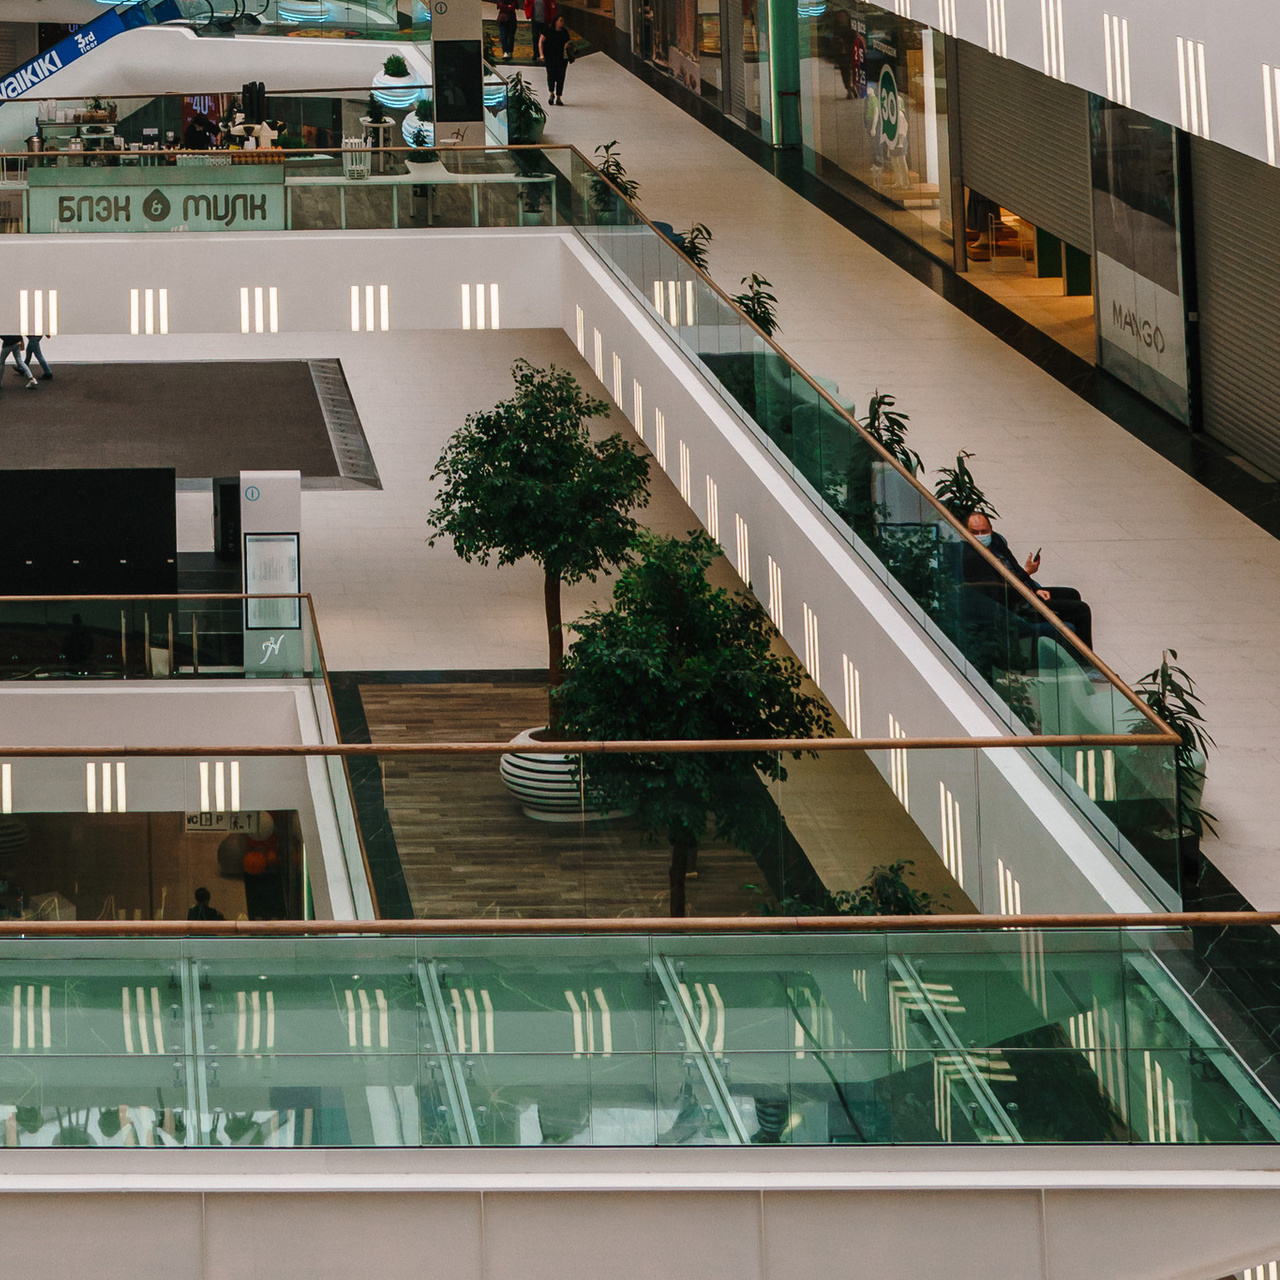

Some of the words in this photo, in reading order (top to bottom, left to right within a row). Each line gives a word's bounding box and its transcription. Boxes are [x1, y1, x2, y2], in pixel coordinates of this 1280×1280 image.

[74, 31, 96, 49] 3rd
[80, 40, 98, 54] floor
[880, 87, 897, 126] 30
[1112, 299, 1166, 355] MANGO
[186, 815, 199, 824] WC
[216, 814, 224, 824] P
